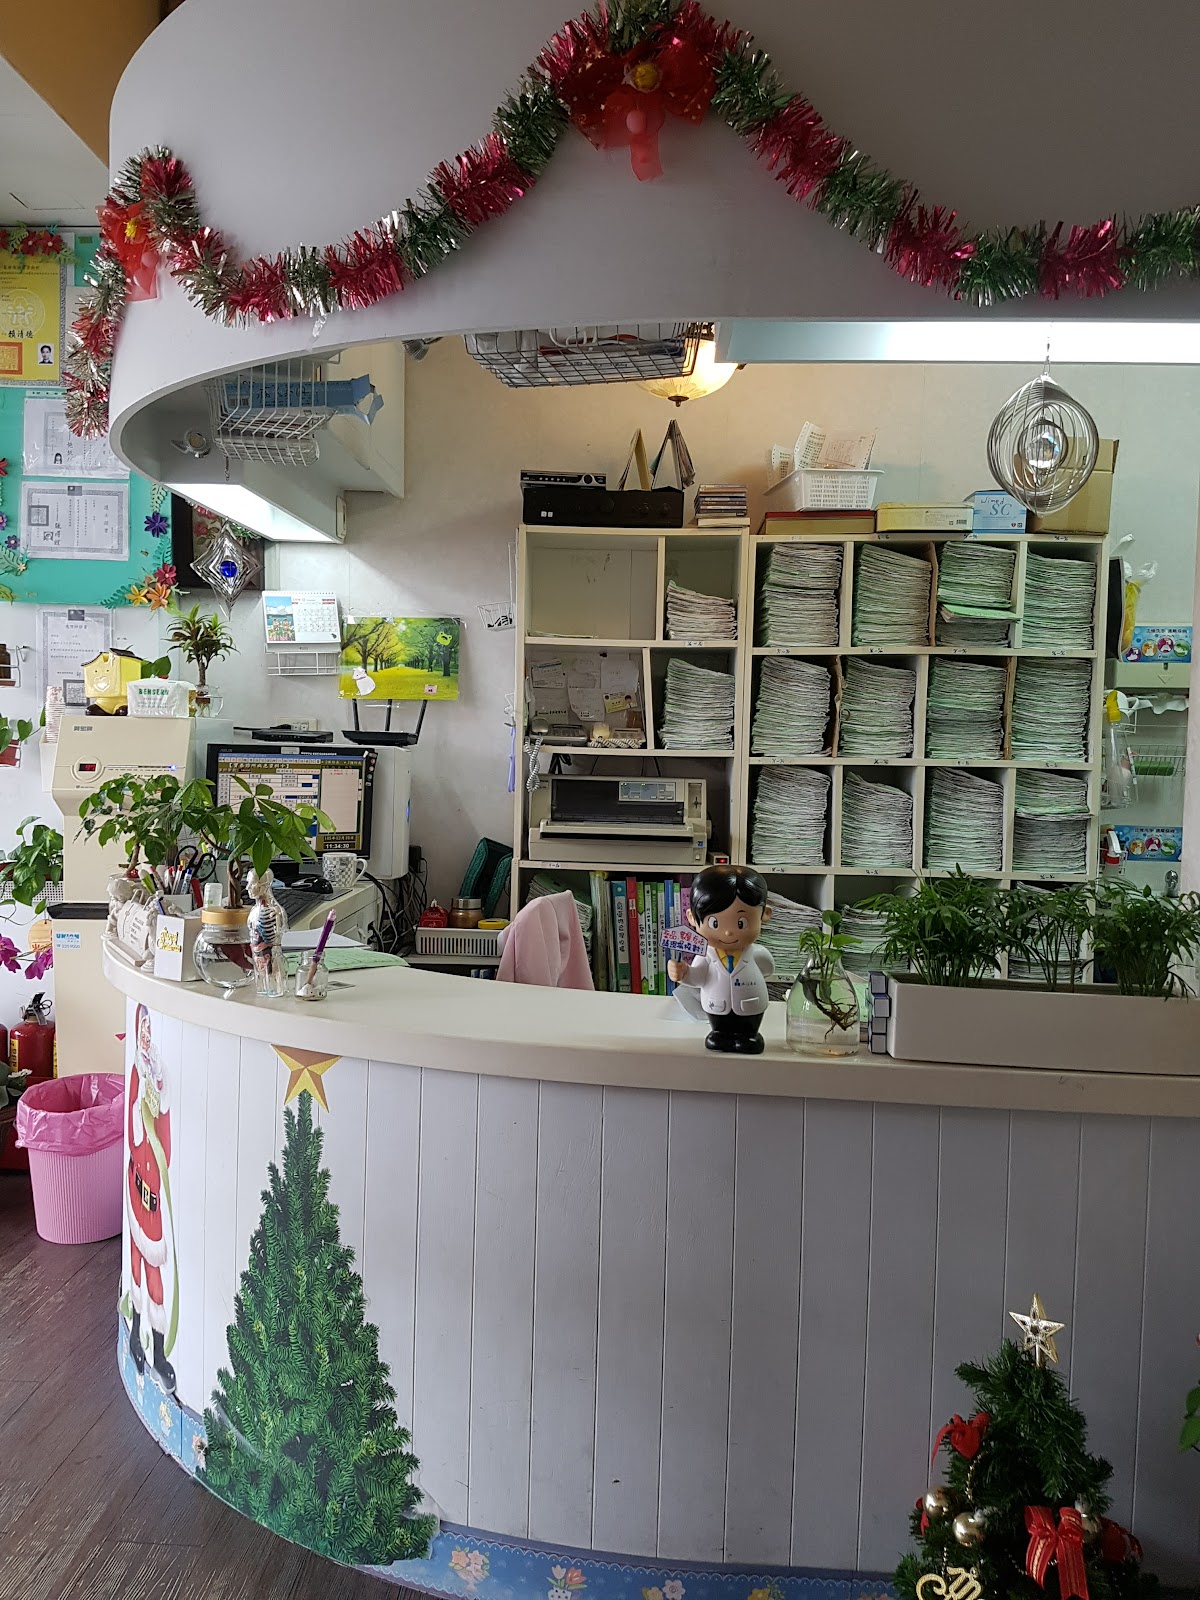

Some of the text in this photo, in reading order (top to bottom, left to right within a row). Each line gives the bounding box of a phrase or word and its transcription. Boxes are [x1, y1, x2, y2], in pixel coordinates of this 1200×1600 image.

[8, 330, 34, 338] 賴清德
[990, 503, 1012, 516] SC
